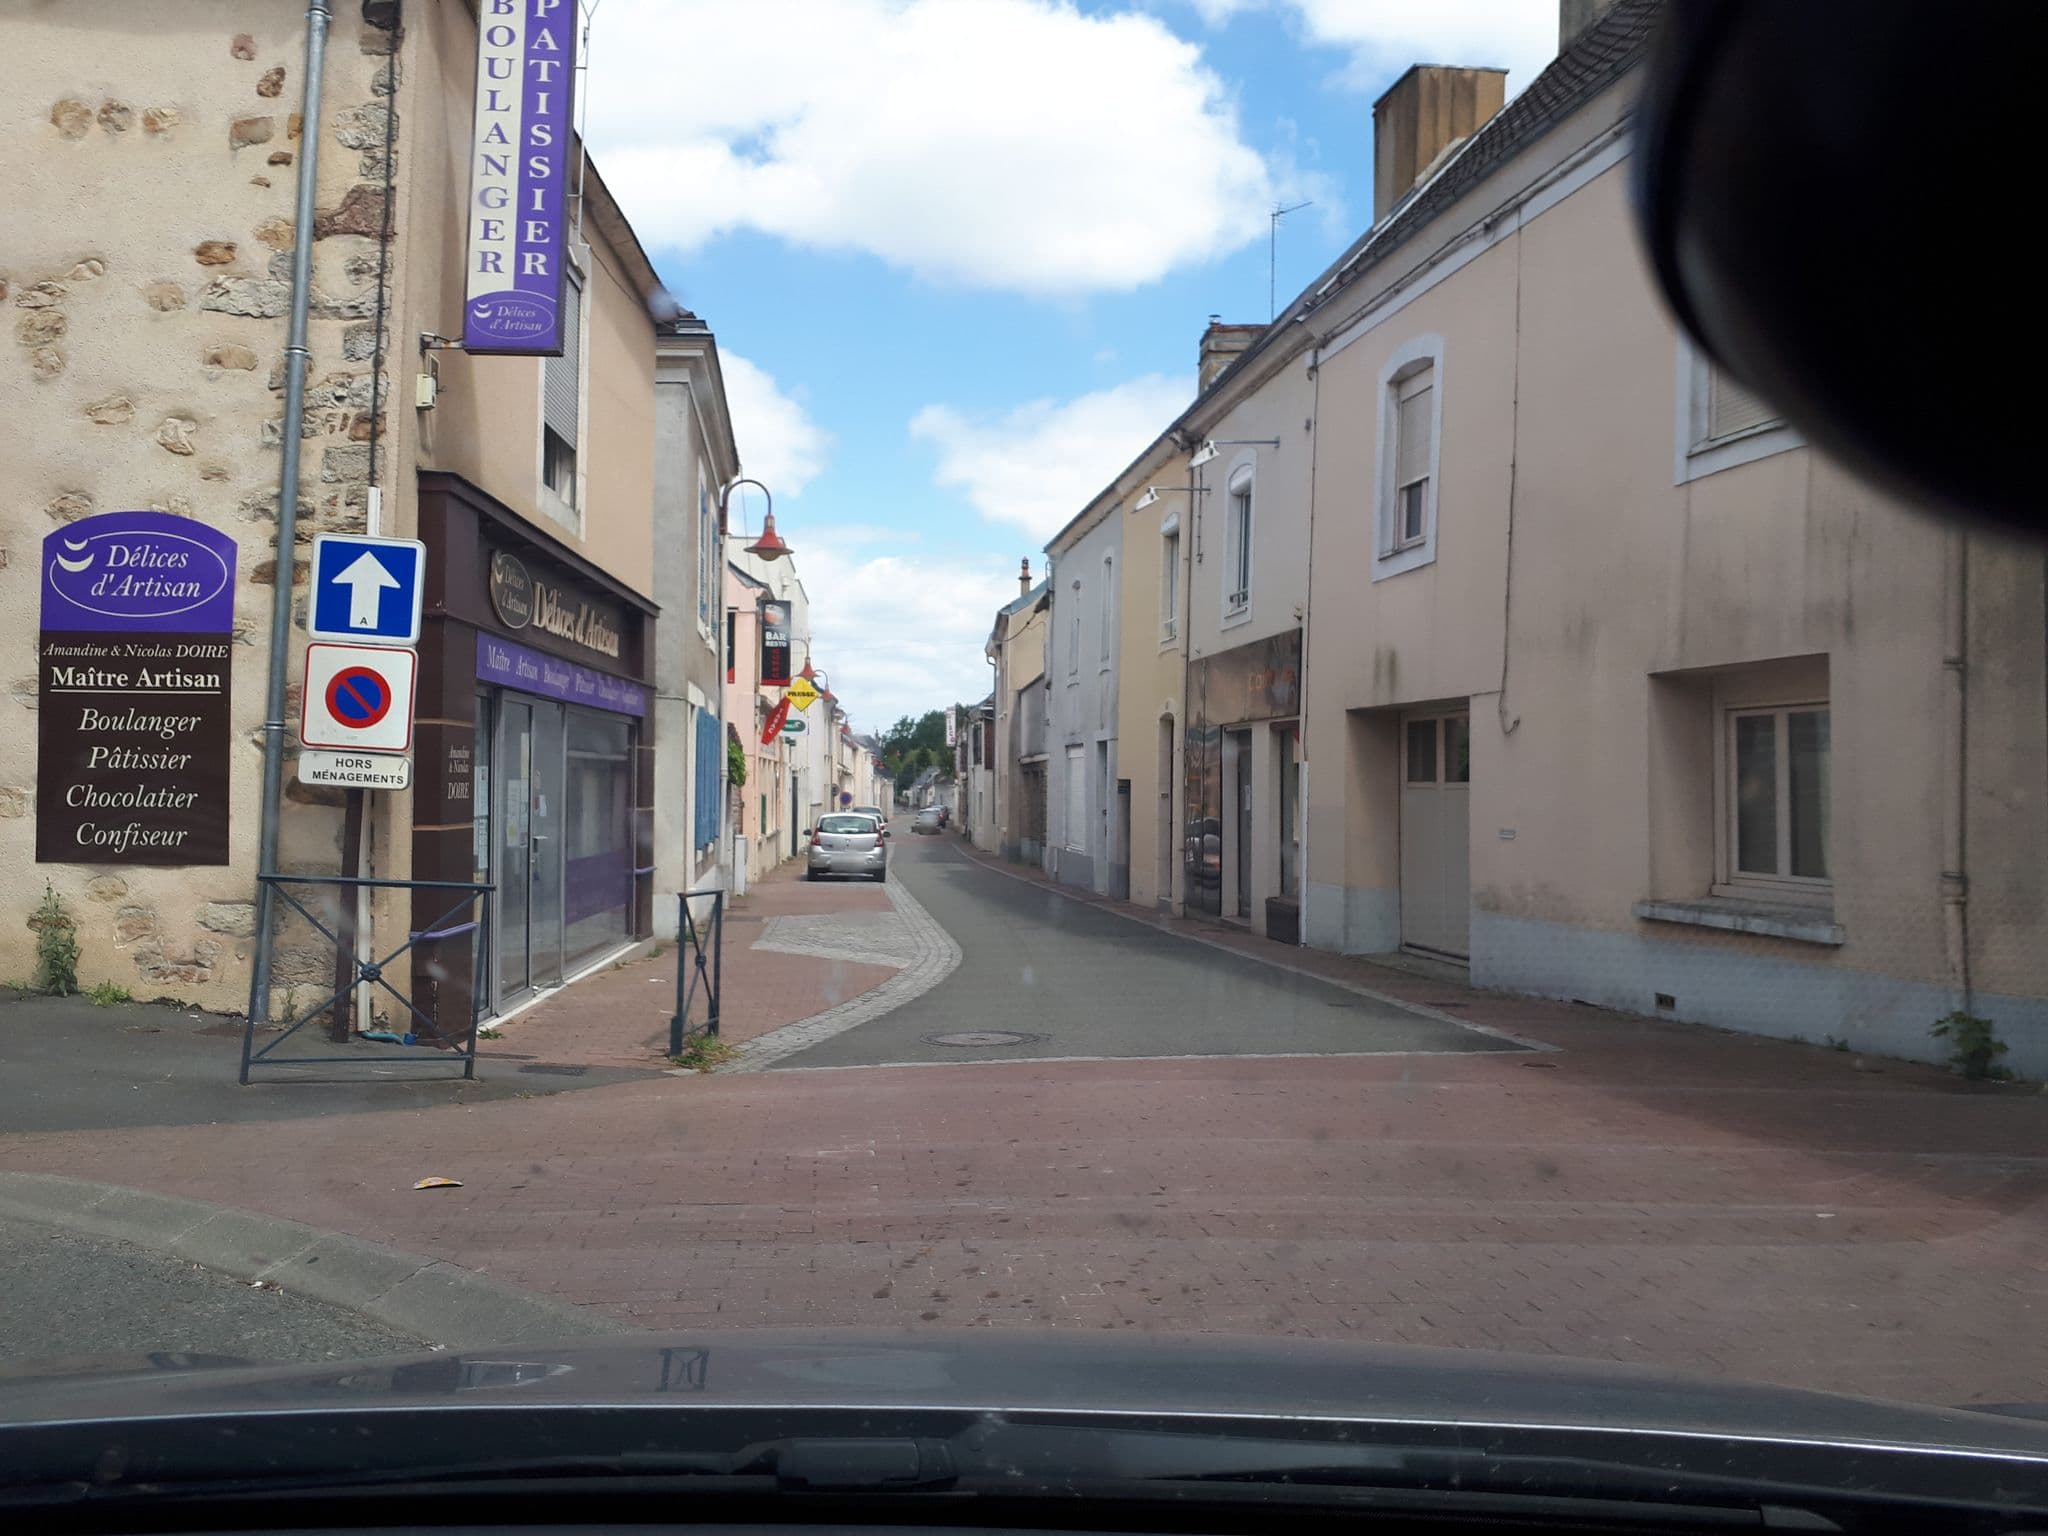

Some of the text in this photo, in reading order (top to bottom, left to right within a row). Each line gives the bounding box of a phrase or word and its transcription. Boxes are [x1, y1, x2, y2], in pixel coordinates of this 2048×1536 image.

[477, 0, 516, 274] BOULANGER
[521, 0, 560, 276] PATISSIER
[497, 306, 536, 318] Délices
[489, 318, 542, 330] d'Artisan
[106, 544, 189, 568] Délices
[90, 573, 201, 597] d'Artisan
[359, 616, 368, 626] A
[531, 581, 576, 641] Délices
[765, 631, 786, 641] BAR
[43, 642, 229, 658] Amandine & Nicolas DOIRE
[50, 666, 221, 688] Maître Artisan
[77, 708, 202, 740] Boulanger
[86, 745, 192, 770] Pâtissier
[335, 757, 372, 769] HORS
[312, 768, 404, 785] MÉNAGEMENTS
[65, 783, 198, 809] Chocolatier
[448, 782, 470, 799] DOIRE
[76, 822, 188, 853] Confiseur
